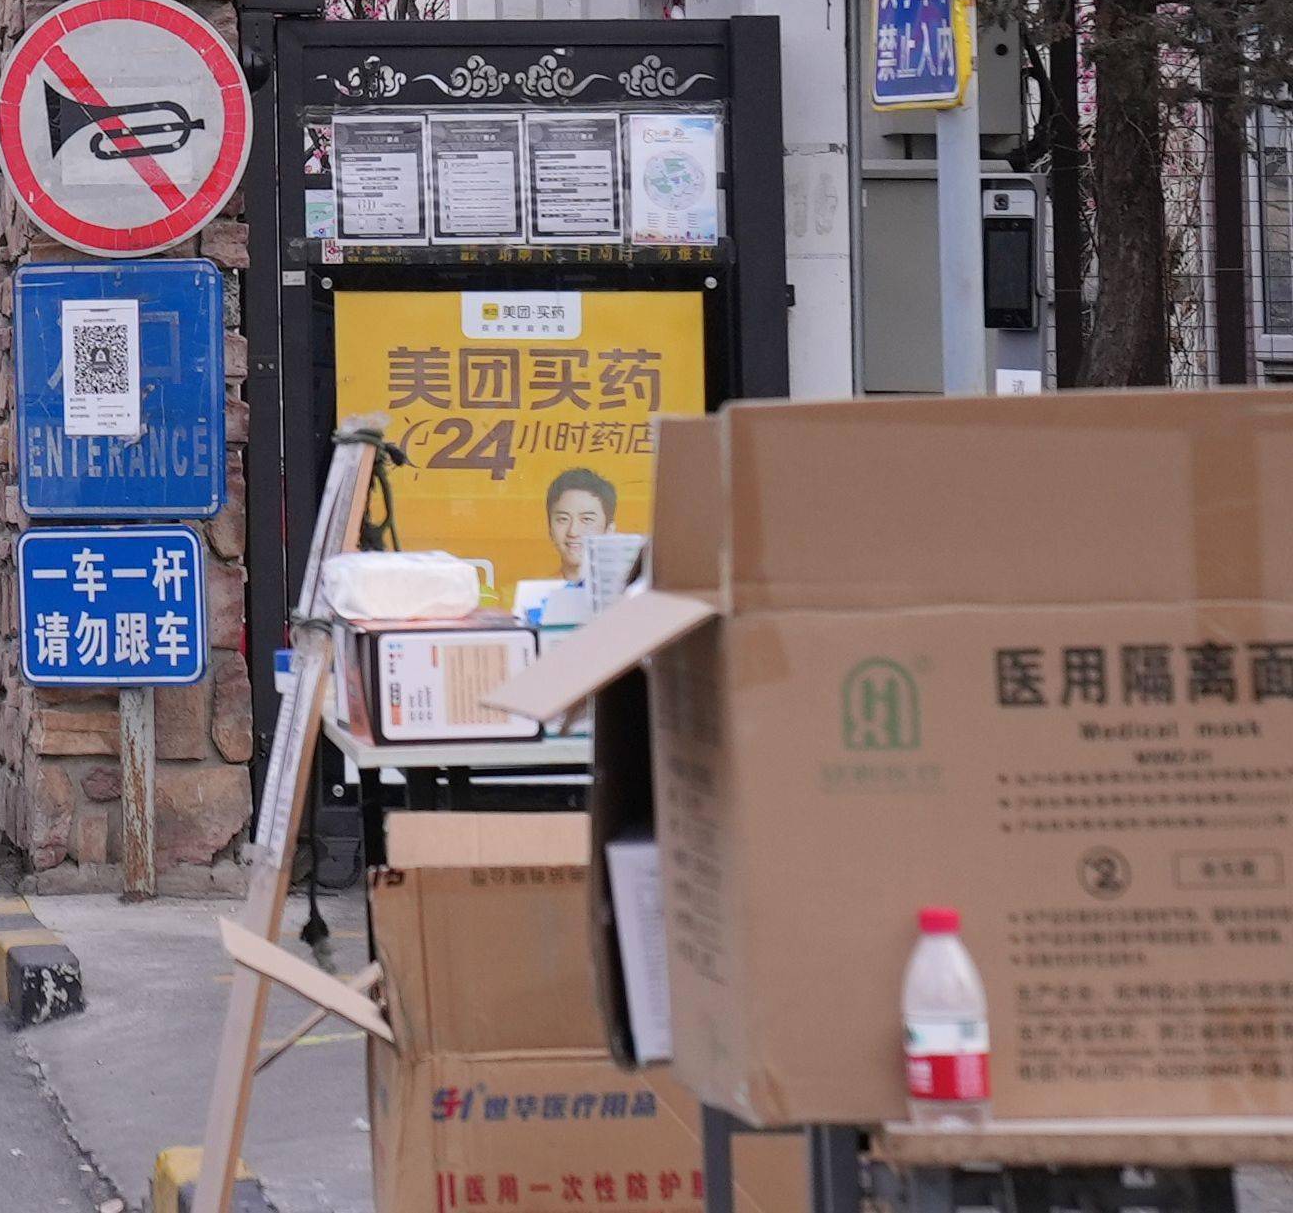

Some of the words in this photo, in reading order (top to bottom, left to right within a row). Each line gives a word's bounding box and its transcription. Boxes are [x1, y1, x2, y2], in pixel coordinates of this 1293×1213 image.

[877, 18, 955, 82] 禁止入内
[388, 346, 662, 412] 美团买药
[32, 546, 188, 603] 一车一杆
[33, 610, 190, 667] 请勿跟车
